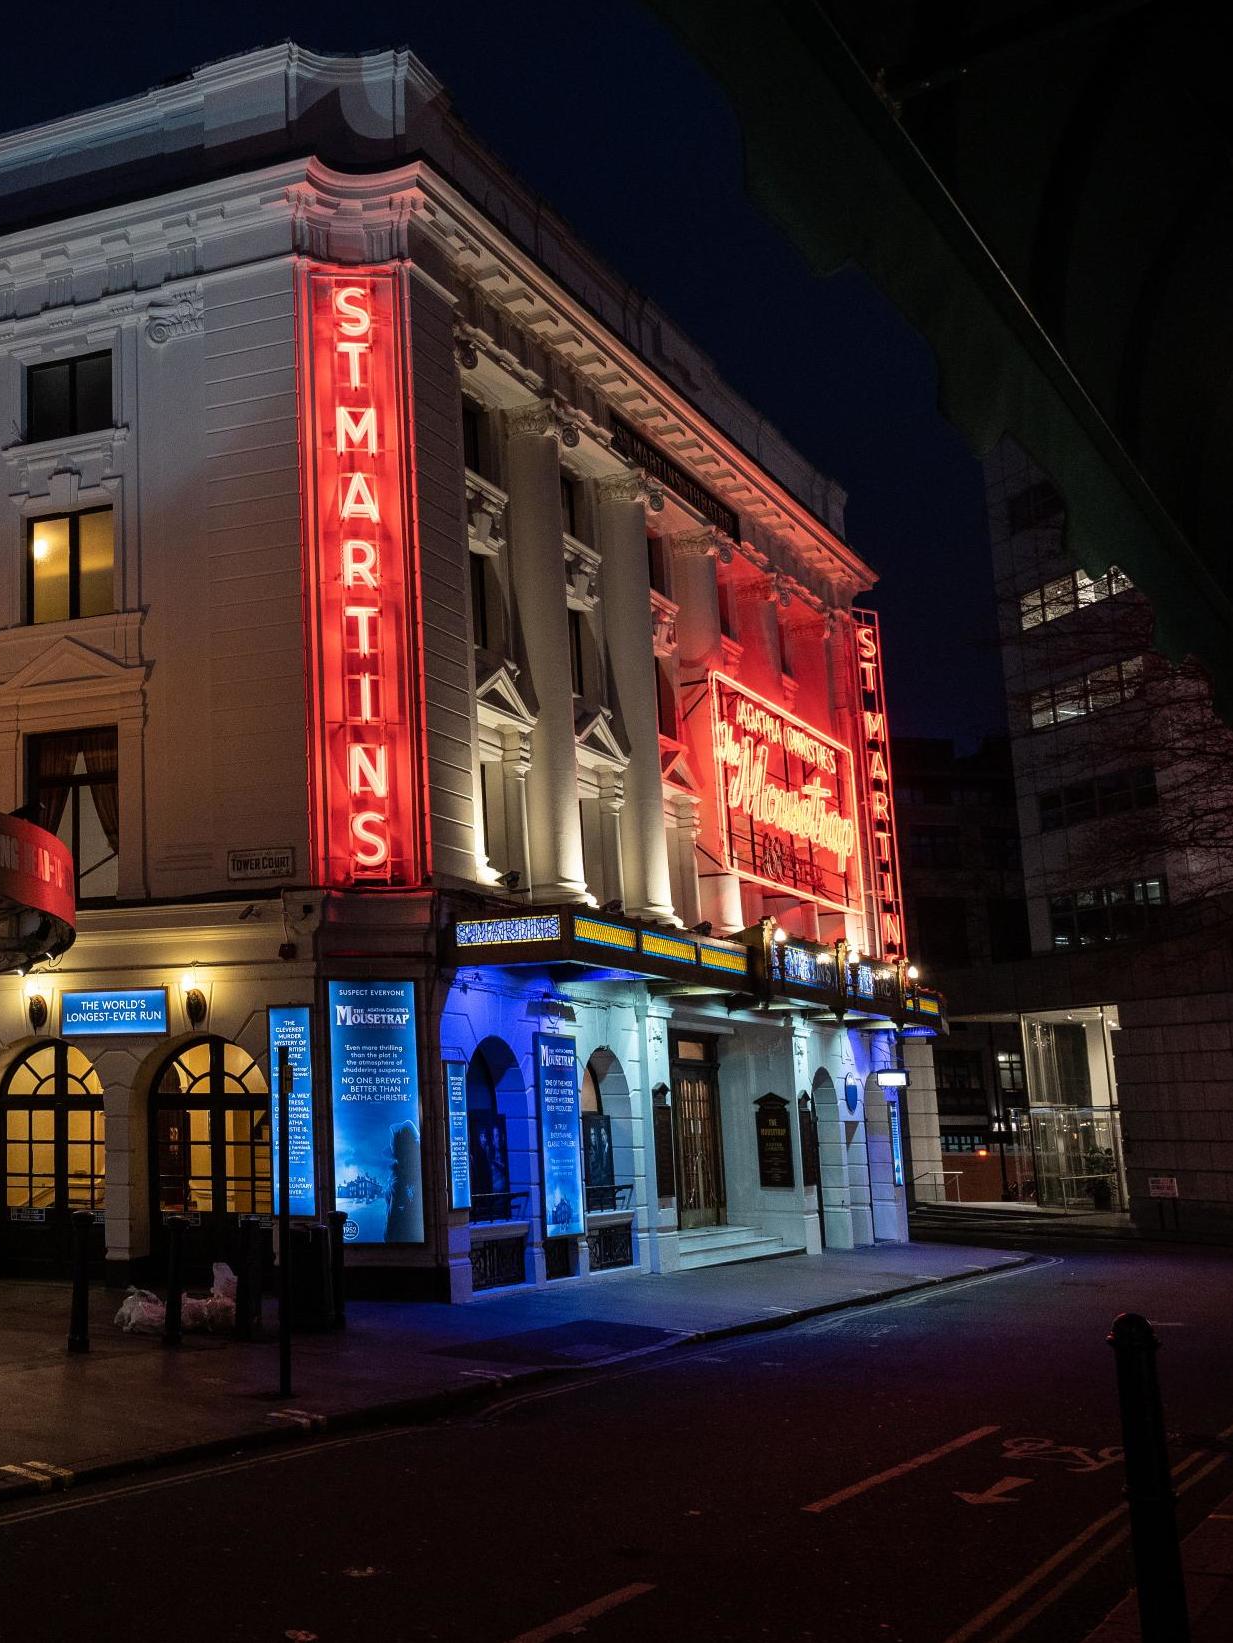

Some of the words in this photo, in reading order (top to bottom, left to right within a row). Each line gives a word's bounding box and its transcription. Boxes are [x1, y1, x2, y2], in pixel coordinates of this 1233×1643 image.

[688, 482, 731, 528] THEATRE
[736, 699, 782, 745] AGATHA
[784, 726, 836, 774] CHRISTIE'S
[231, 858, 260, 872] TOWER
[262, 856, 289, 869] COURT
[370, 989, 404, 997] EVERYONE
[81, 1001, 99, 1011] THE
[102, 1000, 146, 1010] WORLD'S
[66, 1012, 137, 1022] LONGEST-EVER
[140, 1011, 162, 1020] RUN
[336, 1005, 410, 1026] MOUSETRAP
[379, 1044, 403, 1053] thrilling
[540, 1044, 575, 1067] MOUSETRAP
[343, 1067, 377, 1075] shuddering
